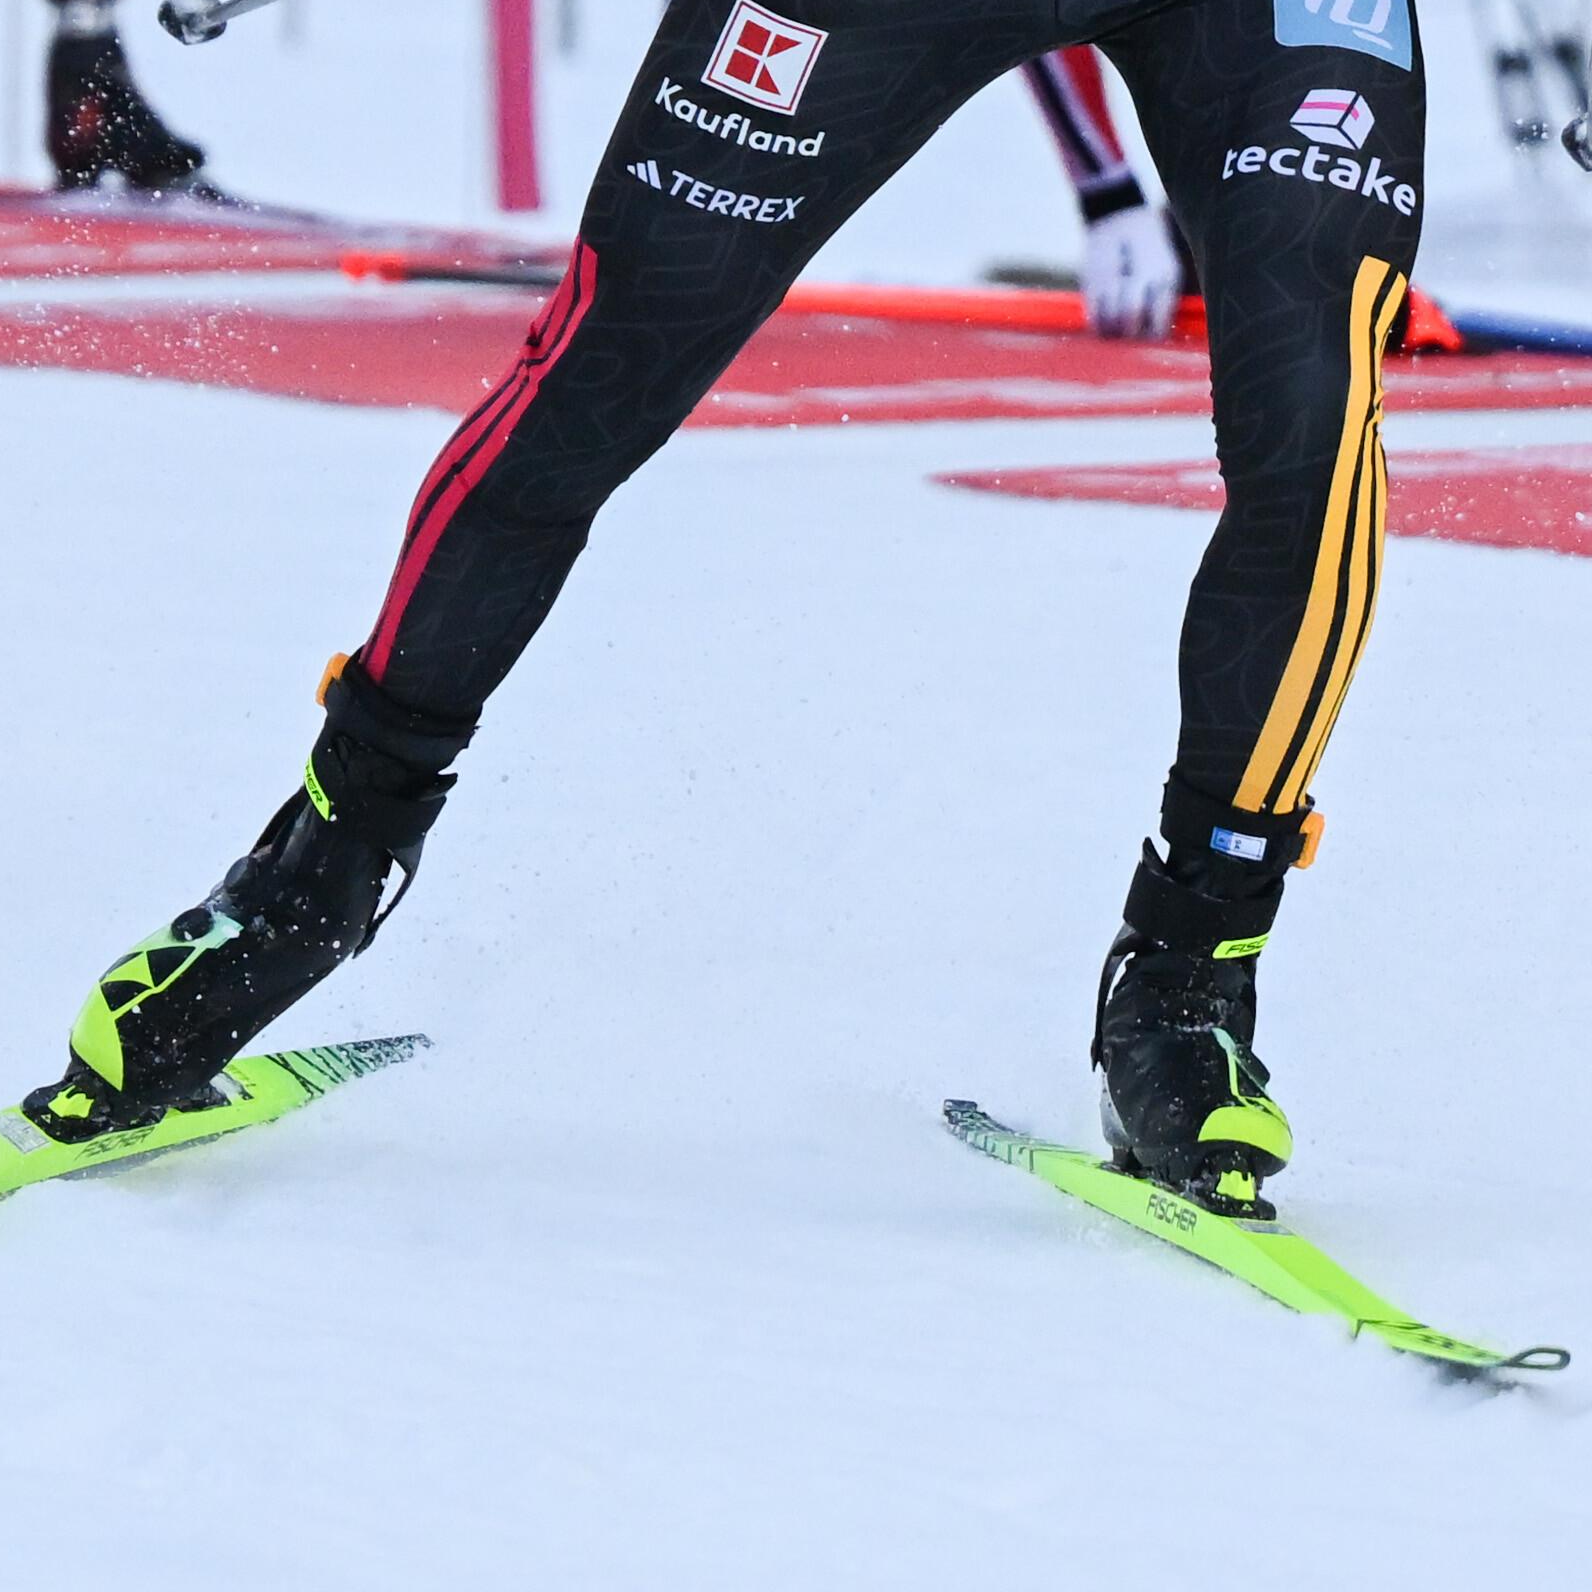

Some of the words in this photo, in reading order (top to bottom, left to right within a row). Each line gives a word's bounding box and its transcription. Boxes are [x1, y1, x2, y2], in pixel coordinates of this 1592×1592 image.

[655, 76, 826, 157] Kaufland
[669, 170, 806, 223] TERREX
[1221, 144, 1417, 217] tectake
[1145, 1193, 1198, 1237] FISCHER
